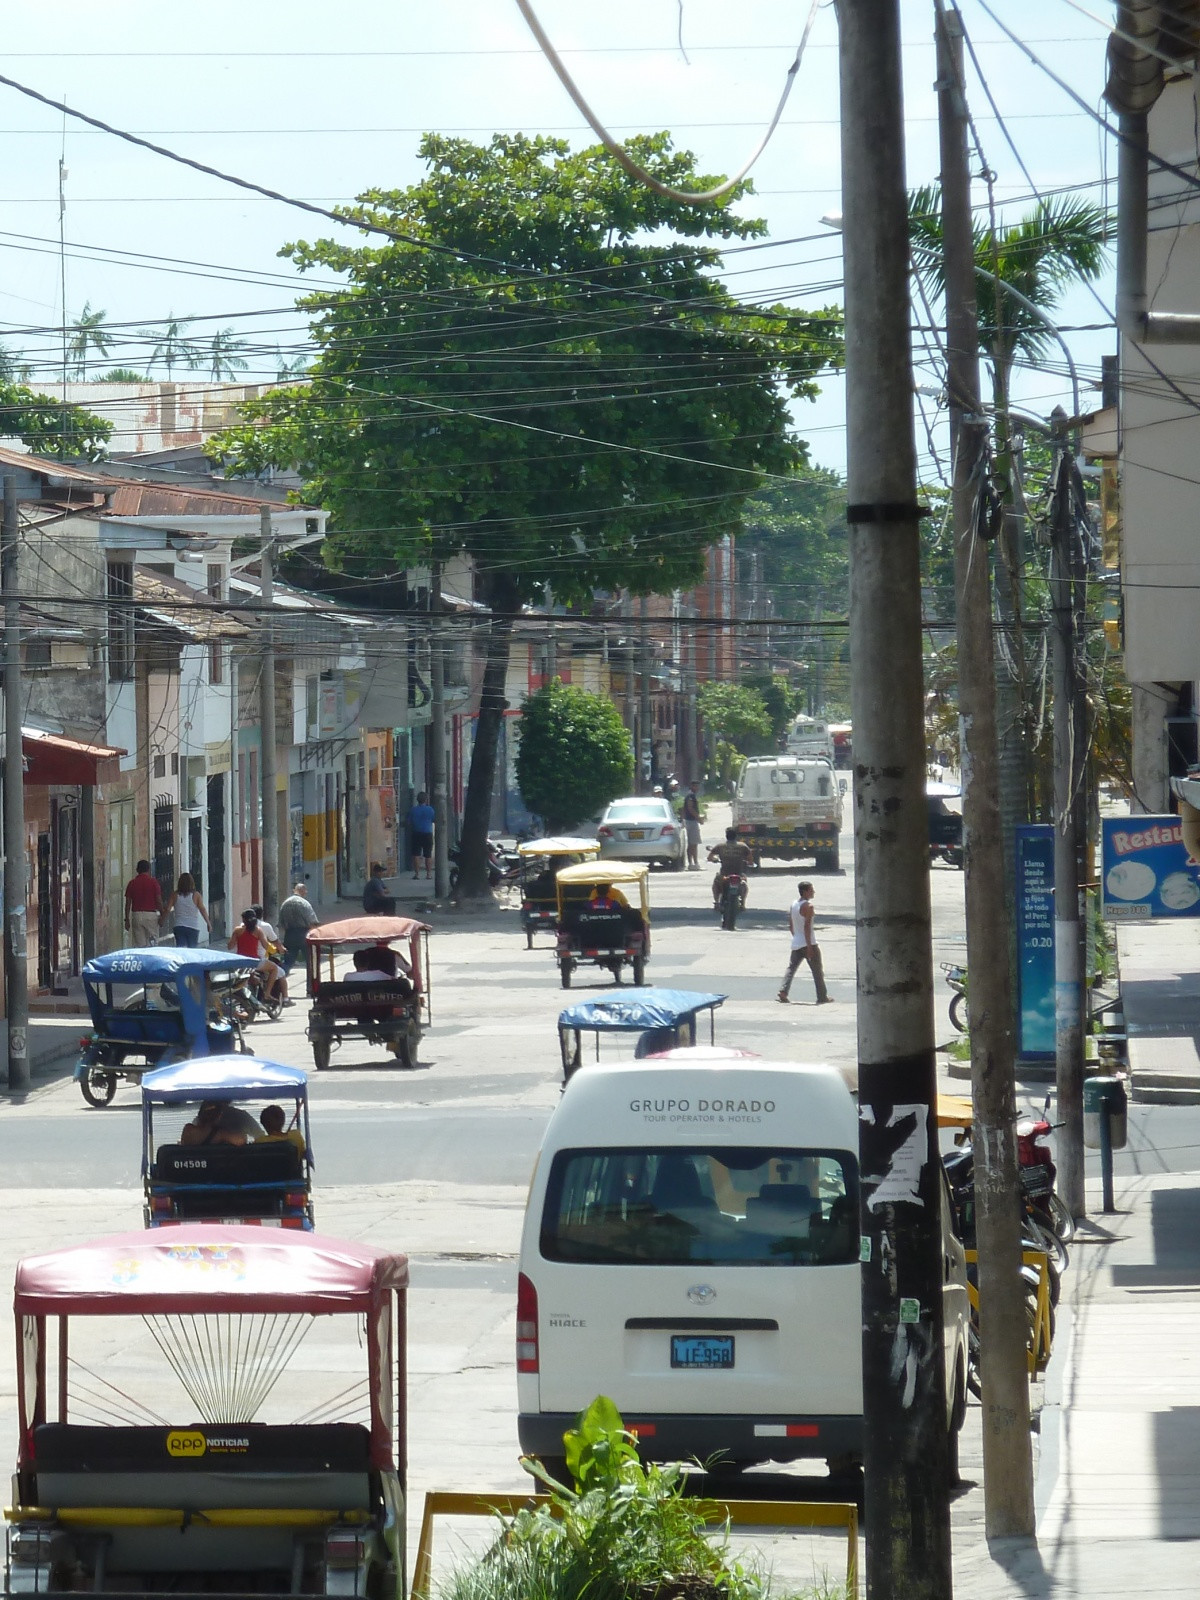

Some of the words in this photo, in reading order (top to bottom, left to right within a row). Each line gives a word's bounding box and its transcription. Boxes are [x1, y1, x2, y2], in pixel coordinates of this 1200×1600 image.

[1114, 826, 1183, 853] Restau
[1024, 860, 1045, 868] Llama
[1031, 895, 1045, 904] fijos
[1031, 937, 1052, 947] 0.20
[111, 960, 142, 972] 53086
[629, 1099, 690, 1112] GRUPO
[698, 1100, 776, 1113] DORADO
[643, 1114, 667, 1122] TOUR
[669, 1114, 715, 1123] OPERATOR
[728, 1115, 762, 1123] HOTELS
[549, 1319, 588, 1328] HIACE
[206, 1438, 249, 1447] NOTICIAS
